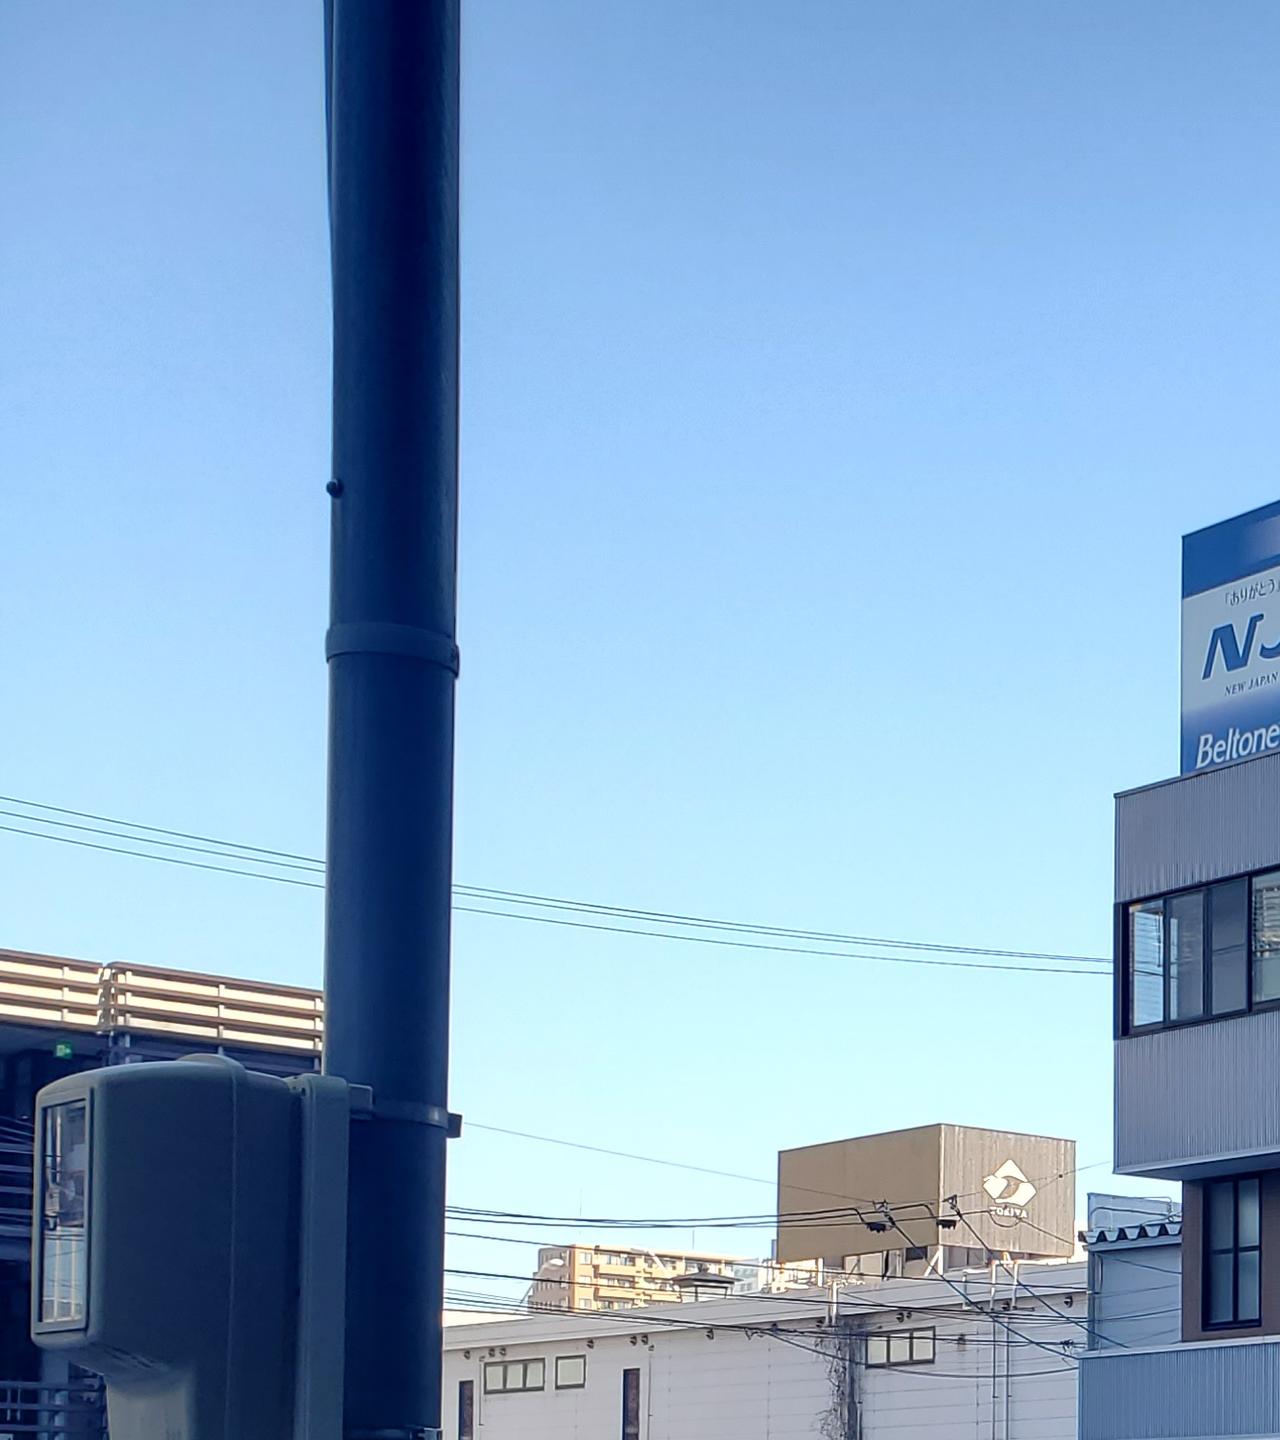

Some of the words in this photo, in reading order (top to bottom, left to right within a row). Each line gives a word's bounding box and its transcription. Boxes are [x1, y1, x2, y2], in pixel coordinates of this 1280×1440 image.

[1224, 682, 1246, 697] NEW
[1247, 671, 1279, 690] JAPAN
[1194, 723, 1280, 770] Beltone
